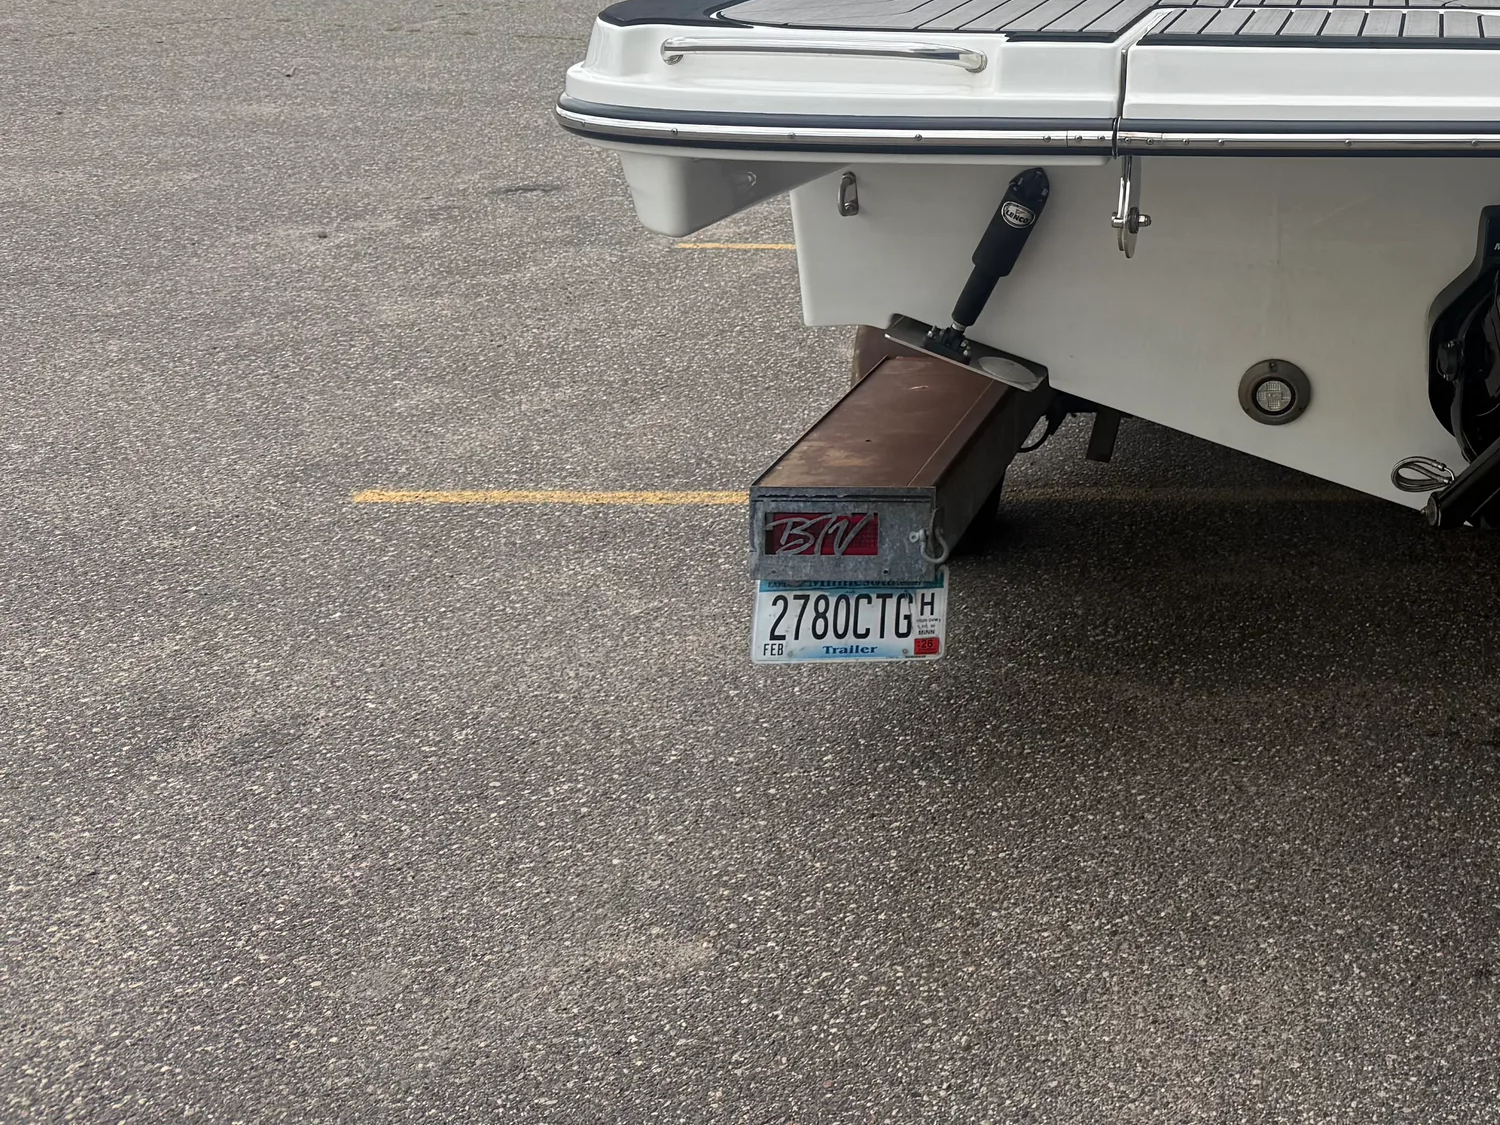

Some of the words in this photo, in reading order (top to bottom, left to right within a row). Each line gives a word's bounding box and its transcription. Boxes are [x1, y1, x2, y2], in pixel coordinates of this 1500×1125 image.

[1005, 209, 1029, 224] LENCO
[920, 592, 936, 617] H
[769, 592, 914, 641] 2780CTG
[763, 643, 784, 657] FEB
[822, 644, 878, 655] Trailer
